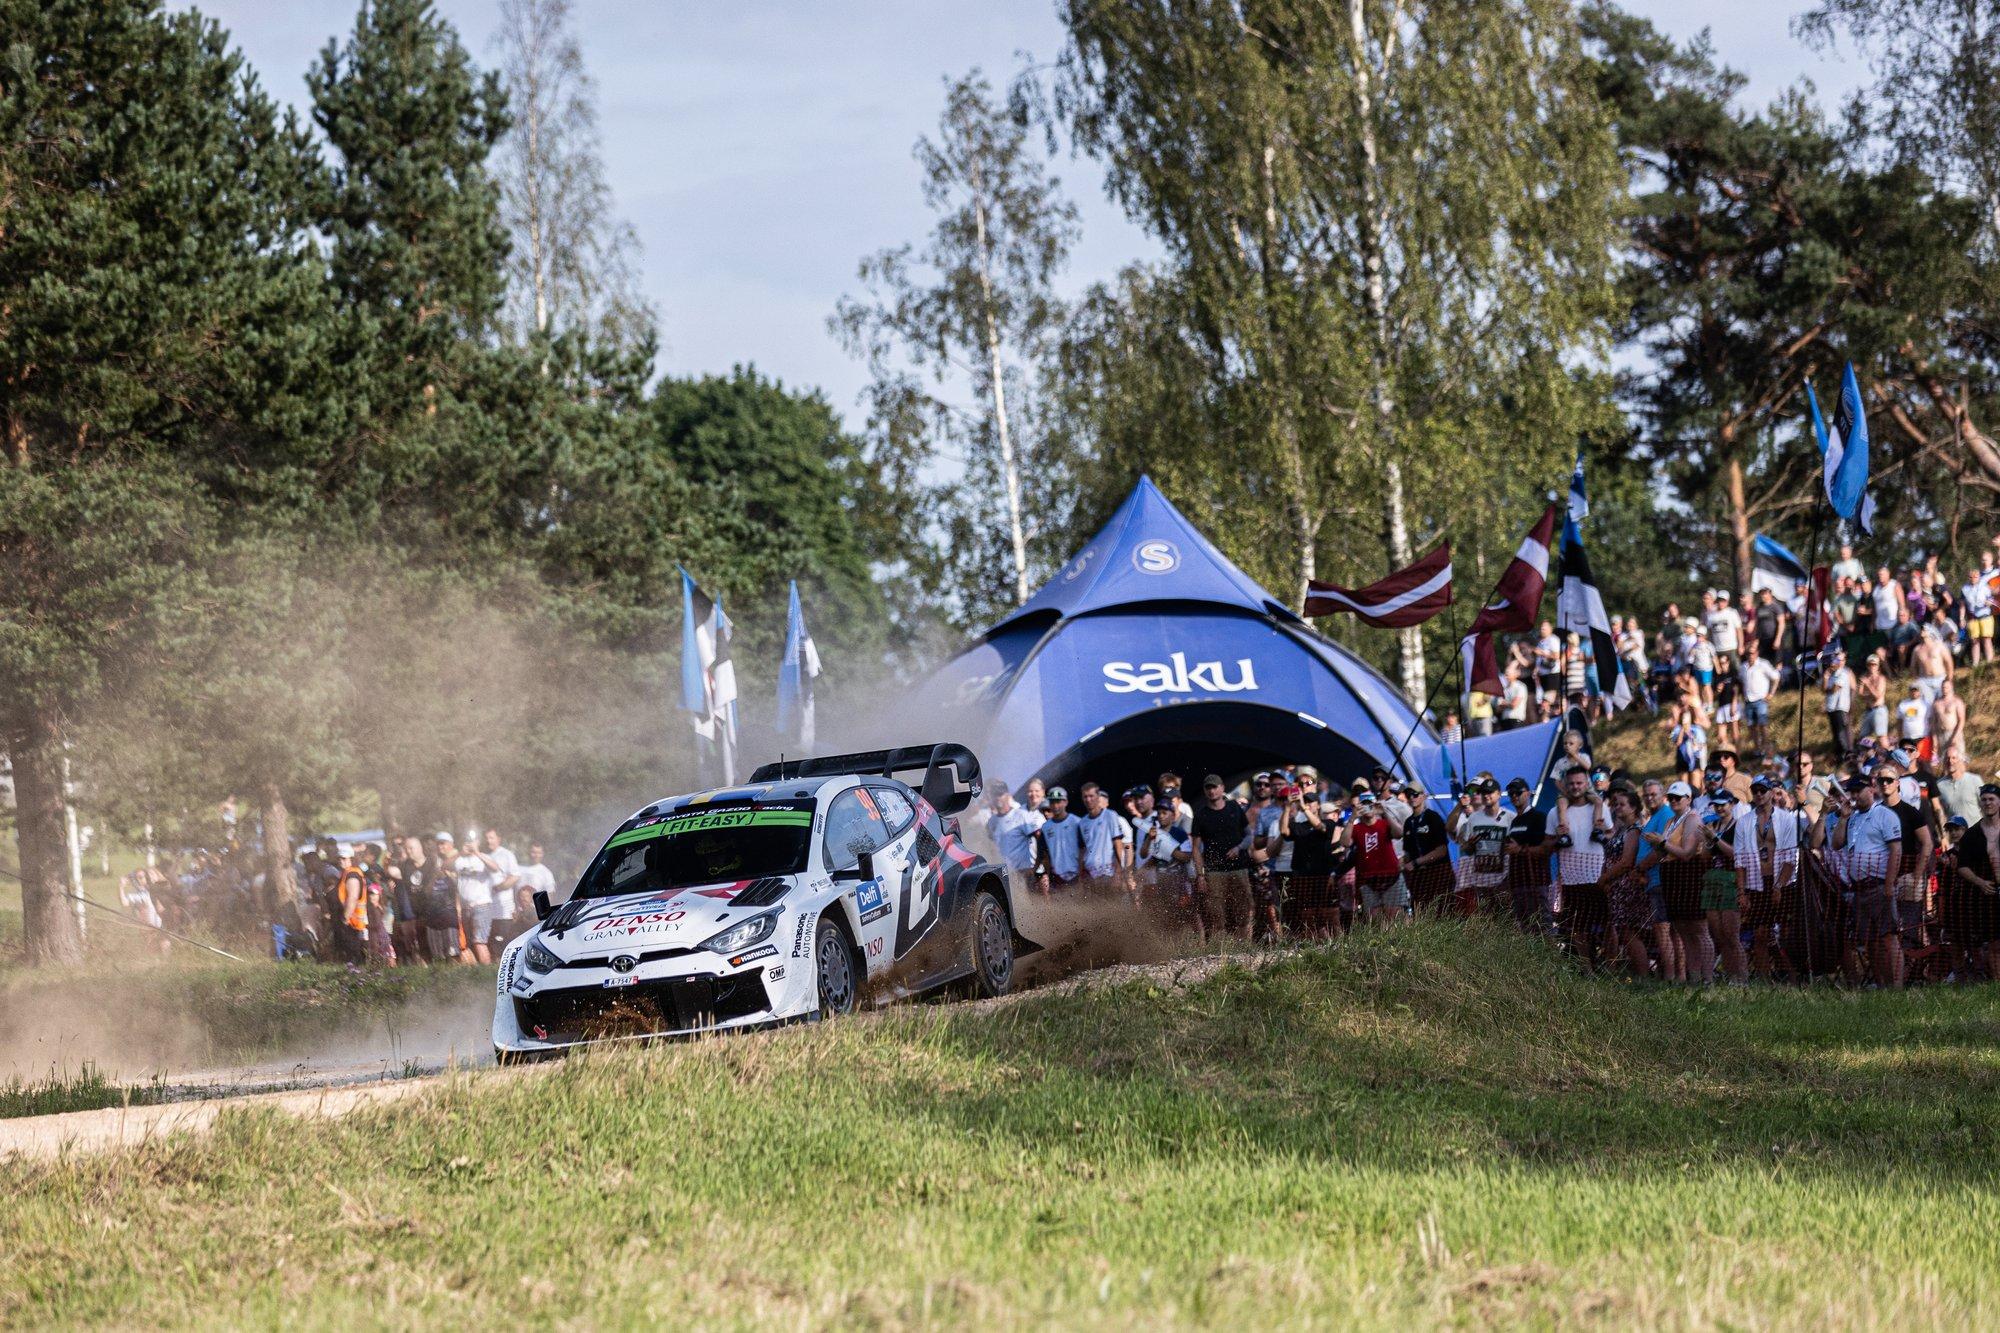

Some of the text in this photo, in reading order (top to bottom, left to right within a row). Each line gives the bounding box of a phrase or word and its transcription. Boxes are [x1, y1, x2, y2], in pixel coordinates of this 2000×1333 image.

[1139, 543, 1175, 572] S
[1102, 652, 1259, 693] saku
[660, 811, 705, 823] TOYOTA
[707, 805, 752, 815] GAZOO
[754, 804, 795, 812] Racing
[859, 885, 878, 906] Delfi
[591, 910, 687, 932] DENSO
[582, 928, 627, 942] GRAN
[791, 912, 808, 958] Panasonic
[802, 911, 818, 959] AUTOMOTIVE
[506, 946, 523, 993] Panasonic
[769, 967, 785, 980] OMP
